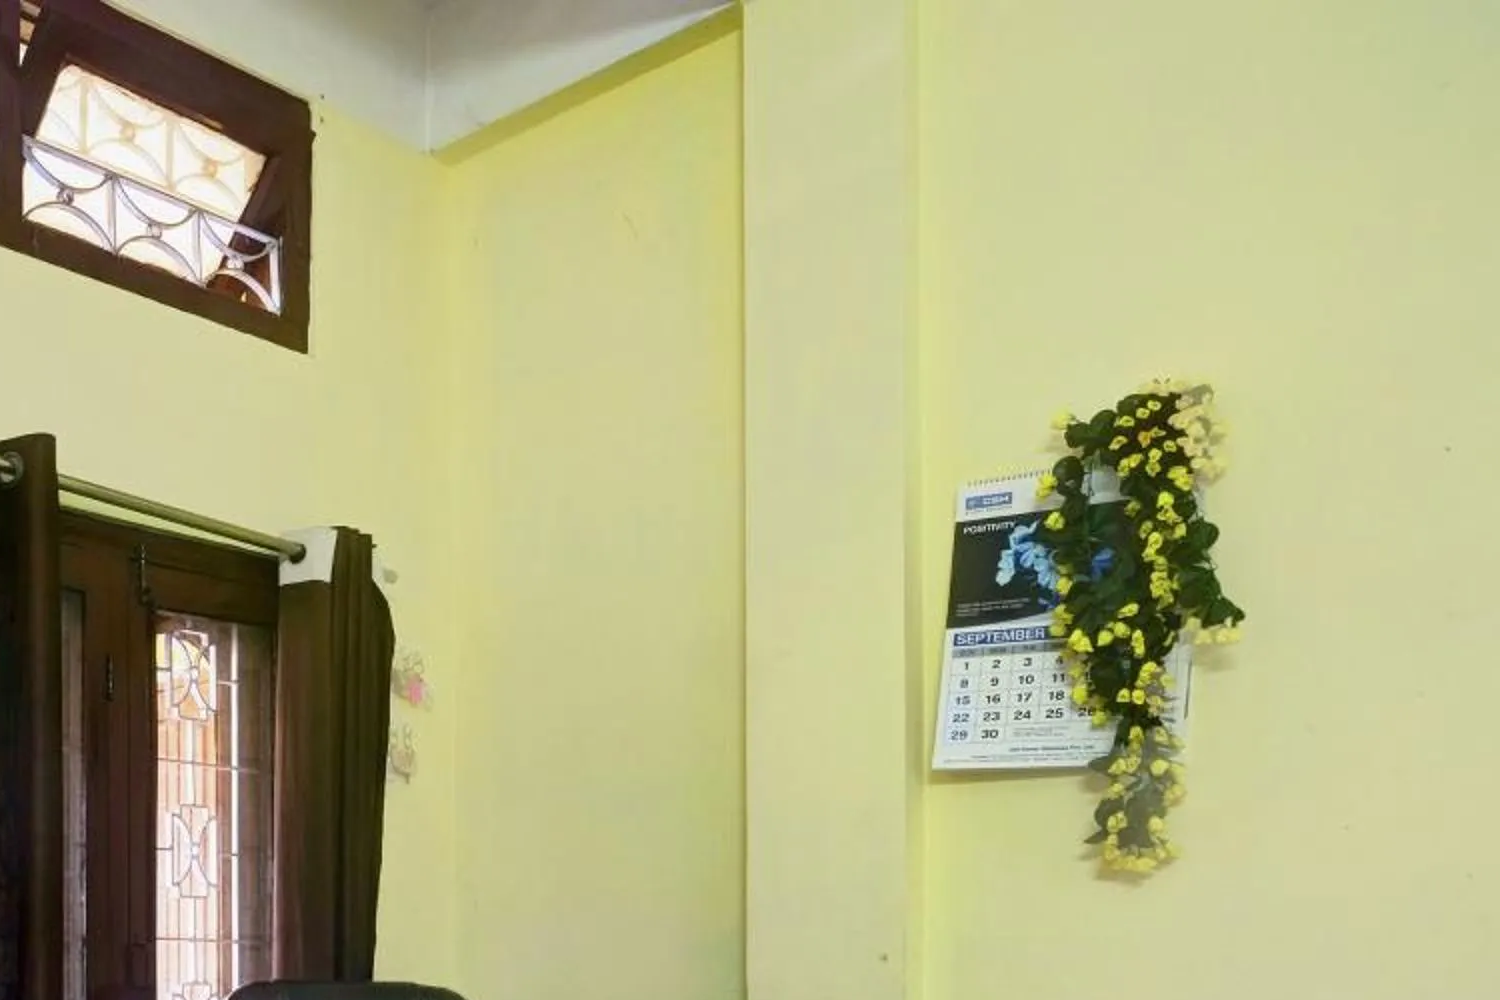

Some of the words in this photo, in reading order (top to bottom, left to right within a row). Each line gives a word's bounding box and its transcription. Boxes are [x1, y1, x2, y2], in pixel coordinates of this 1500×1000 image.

[955, 627, 1046, 645] SEPTEMBER
[964, 661, 970, 671] 1
[992, 659, 1001, 669] 2
[1023, 657, 1033, 667] 3
[960, 678, 969, 689] 8
[990, 676, 999, 687] 9
[1018, 674, 1035, 685] 10
[1052, 672, 1066, 683] 11
[955, 696, 970, 706] 15
[985, 694, 1001, 704] 16
[1016, 691, 1032, 703] 17
[1049, 689, 1066, 701] 18
[953, 713, 970, 723] 22
[983, 711, 1000, 722] 23
[1013, 709, 1032, 721] 24
[1045, 707, 1064, 719] 25
[950, 730, 968, 741] 29
[981, 729, 999, 740] 30
